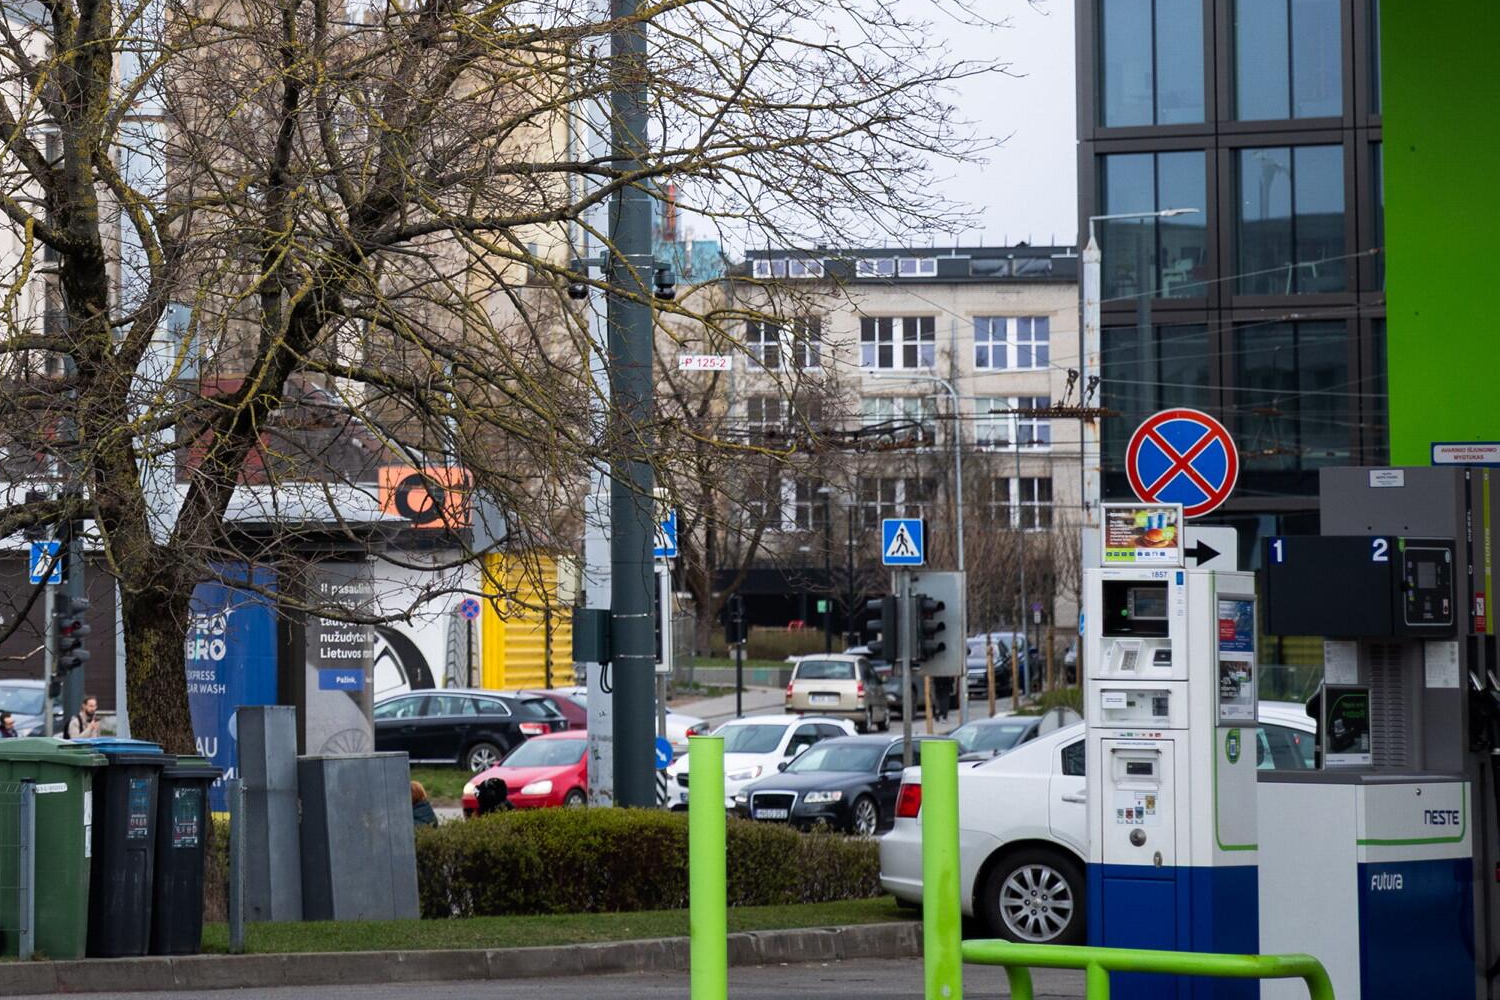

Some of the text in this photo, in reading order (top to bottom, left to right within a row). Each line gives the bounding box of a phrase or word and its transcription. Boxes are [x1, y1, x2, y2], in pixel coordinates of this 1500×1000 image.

[1273, 539, 1283, 562] 1
[1372, 538, 1388, 561] 2
[187, 639, 227, 661] BRO
[320, 648, 361, 659] Lietuvos
[200, 683, 226, 694] WASH
[1424, 810, 1459, 825] NESTE
[1371, 872, 1403, 891] Futura
